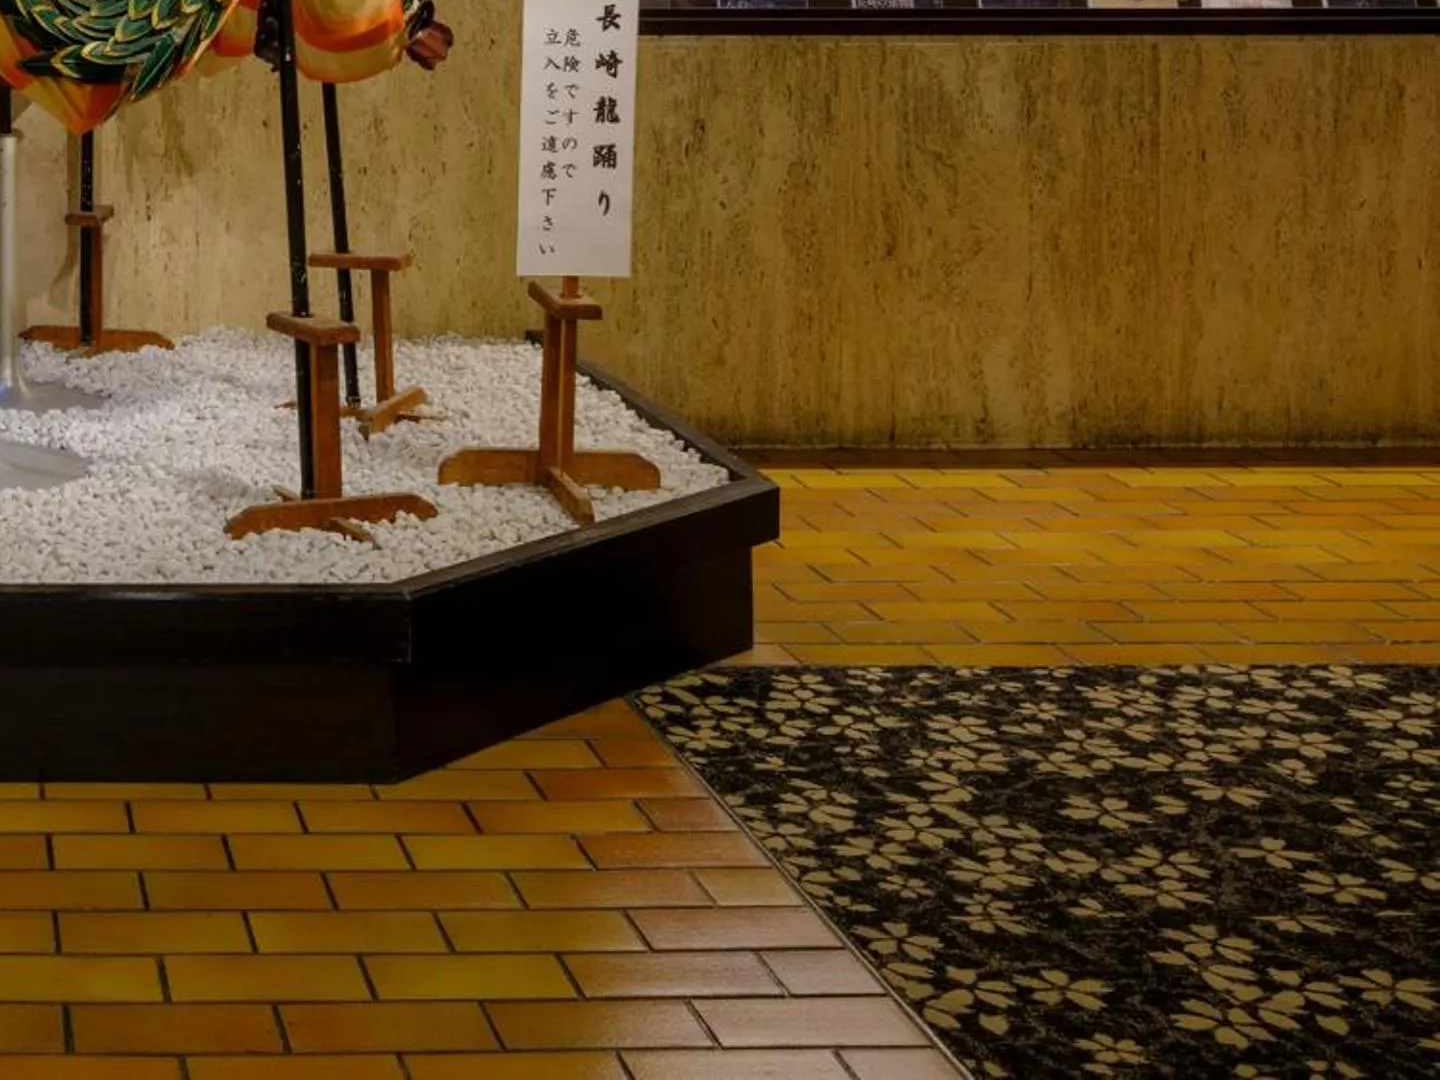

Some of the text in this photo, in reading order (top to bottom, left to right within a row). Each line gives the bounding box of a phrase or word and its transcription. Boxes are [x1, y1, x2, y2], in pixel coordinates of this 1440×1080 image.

[538, 28, 562, 256] 立入をご遠慮下さい
[562, 28, 581, 179] 危険ですので
[592, 3, 623, 217] 長崎龍踊り
